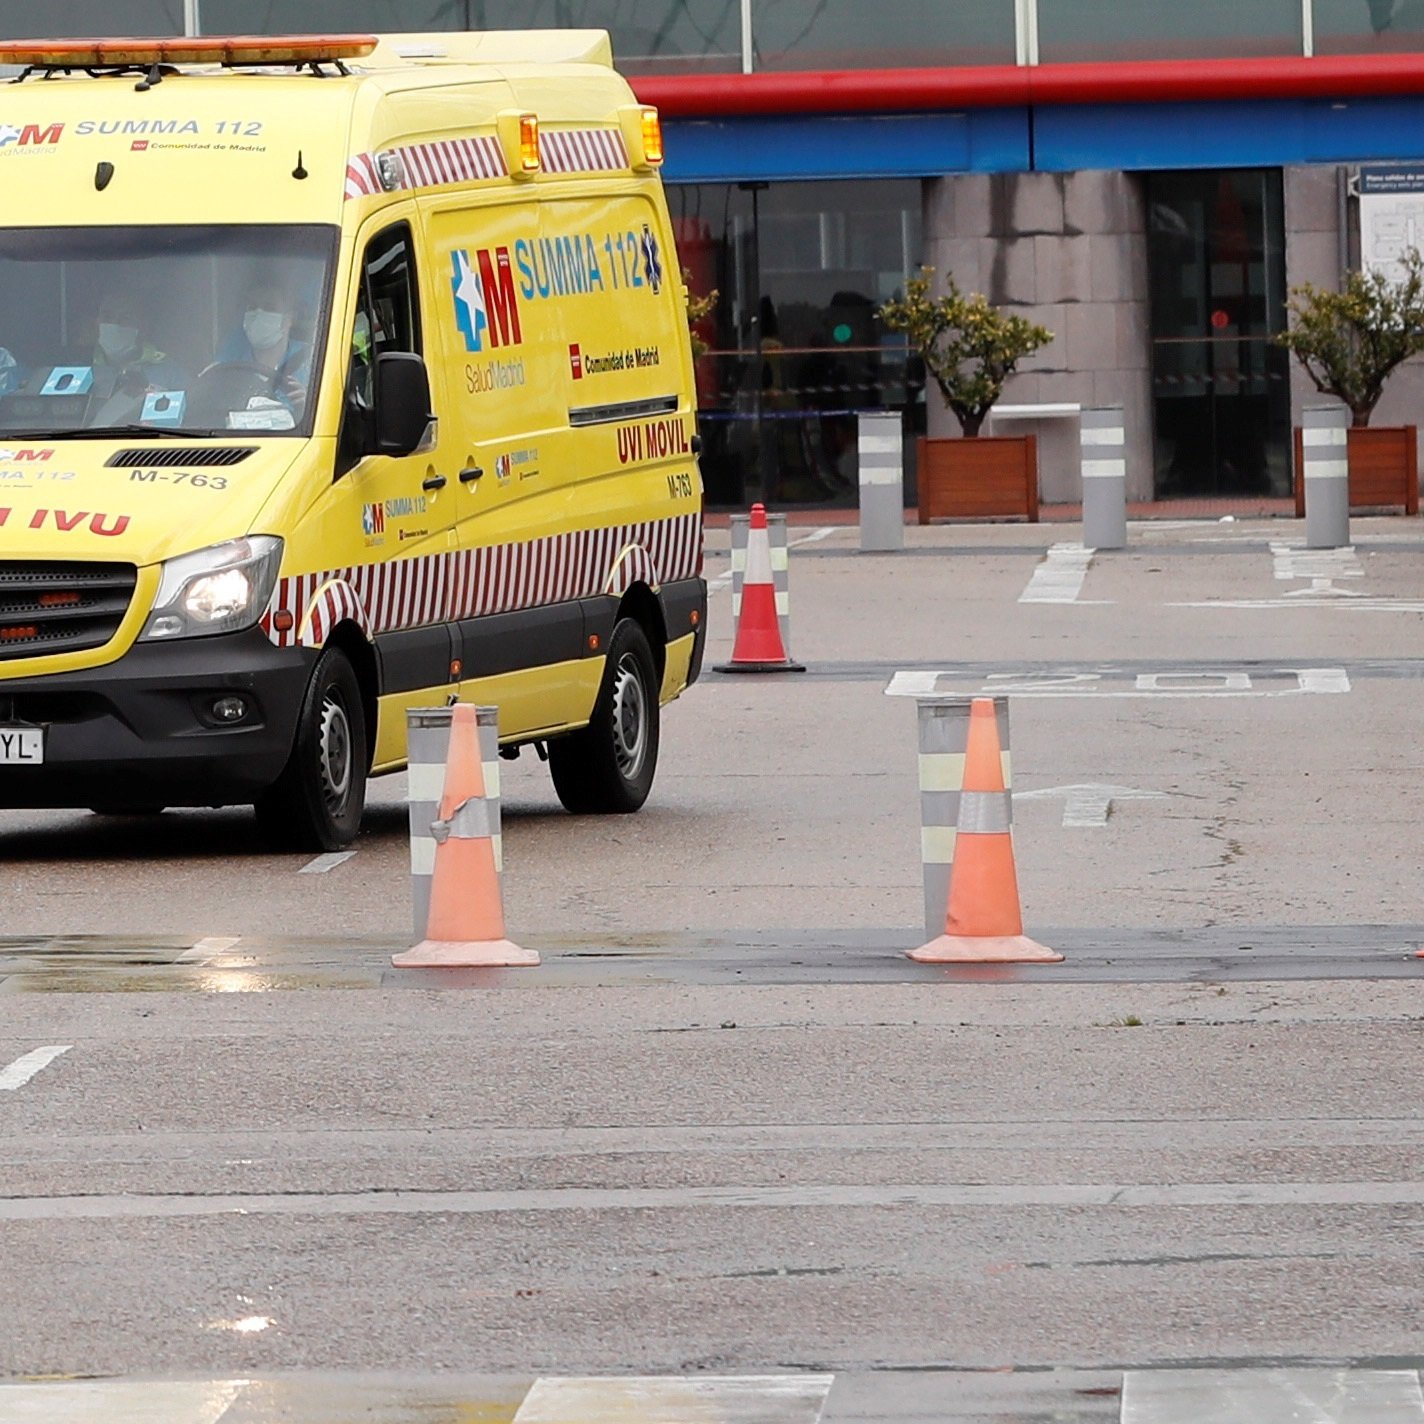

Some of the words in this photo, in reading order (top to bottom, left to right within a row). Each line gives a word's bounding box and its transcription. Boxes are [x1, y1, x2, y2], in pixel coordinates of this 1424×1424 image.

[74, 120, 199, 135] SUMMA
[214, 121, 263, 136] 112
[150, 142, 211, 151] Comunidad
[229, 144, 267, 153] Madrid
[515, 233, 605, 301] SUMMA
[604, 231, 643, 290] 112
[585, 351, 625, 374] Comunidad
[625, 350, 635, 368] de
[635, 345, 660, 368] Madrid
[465, 356, 525, 394] SaludMadrid
[616, 424, 643, 464] UVI
[644, 417, 689, 460] MOVIL
[35, 471, 76, 481] 112
[128, 469, 228, 490] M-763
[666, 473, 693, 500] M-763
